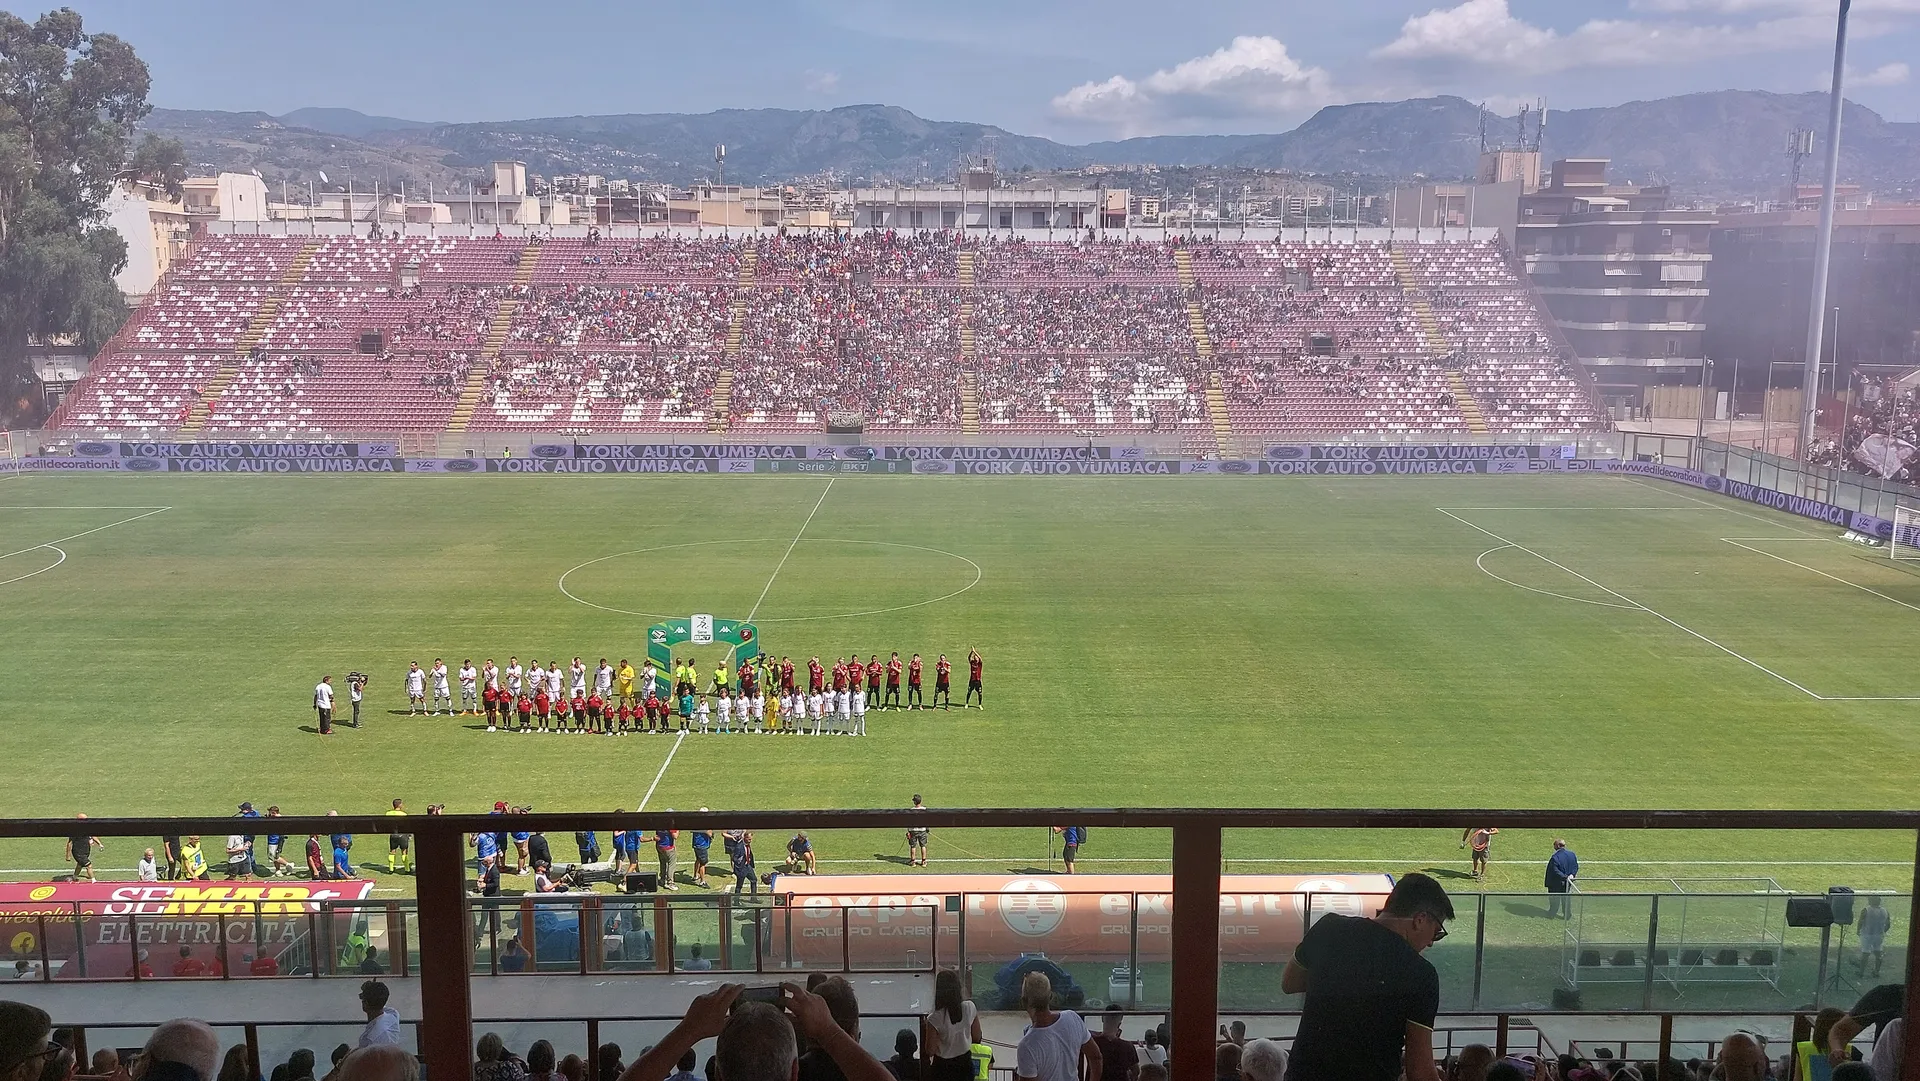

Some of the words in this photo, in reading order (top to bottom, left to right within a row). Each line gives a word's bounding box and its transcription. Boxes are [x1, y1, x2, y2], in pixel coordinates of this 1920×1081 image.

[128, 444, 184, 457] YORK
[190, 444, 243, 457] AUTO
[250, 444, 347, 457] VUMBACA
[583, 446, 640, 458] YORK
[643, 446, 695, 458] AUTO
[700, 446, 796, 458] VUMBACA
[893, 447, 944, 460] YORK
[951, 447, 1002, 460] AUTO
[1007, 447, 1100, 460] VUMBACA
[1319, 447, 1371, 460] YORK
[1376, 447, 1429, 460] AUTO
[1435, 447, 1529, 460] VUMBACA
[176, 459, 229, 472] YORK
[237, 459, 290, 472] AUTO
[297, 459, 395, 472] VUMBACA
[494, 460, 548, 473] YORK
[555, 460, 606, 473] AUTO
[614, 460, 709, 473] VUMBACA
[798, 462, 825, 471] Serie
[843, 462, 867, 471] BKT
[963, 461, 1014, 474] YORK
[1019, 461, 1073, 474] AUTO
[1079, 461, 1170, 474] VUMBACA
[1267, 461, 1319, 474] YORK
[1325, 461, 1377, 474] AUTO
[1384, 461, 1477, 474] VUMBACA
[1528, 460, 1562, 470] EDIL
[1567, 460, 1602, 470] EDIL
[1607, 463, 1703, 485] www.edildecoration.it
[1728, 480, 1754, 501] YORK
[1756, 490, 1786, 510] AUTO
[1788, 497, 1845, 526] VUMBACA
[803, 894, 986, 922] expet
[1099, 894, 1283, 916] exert
